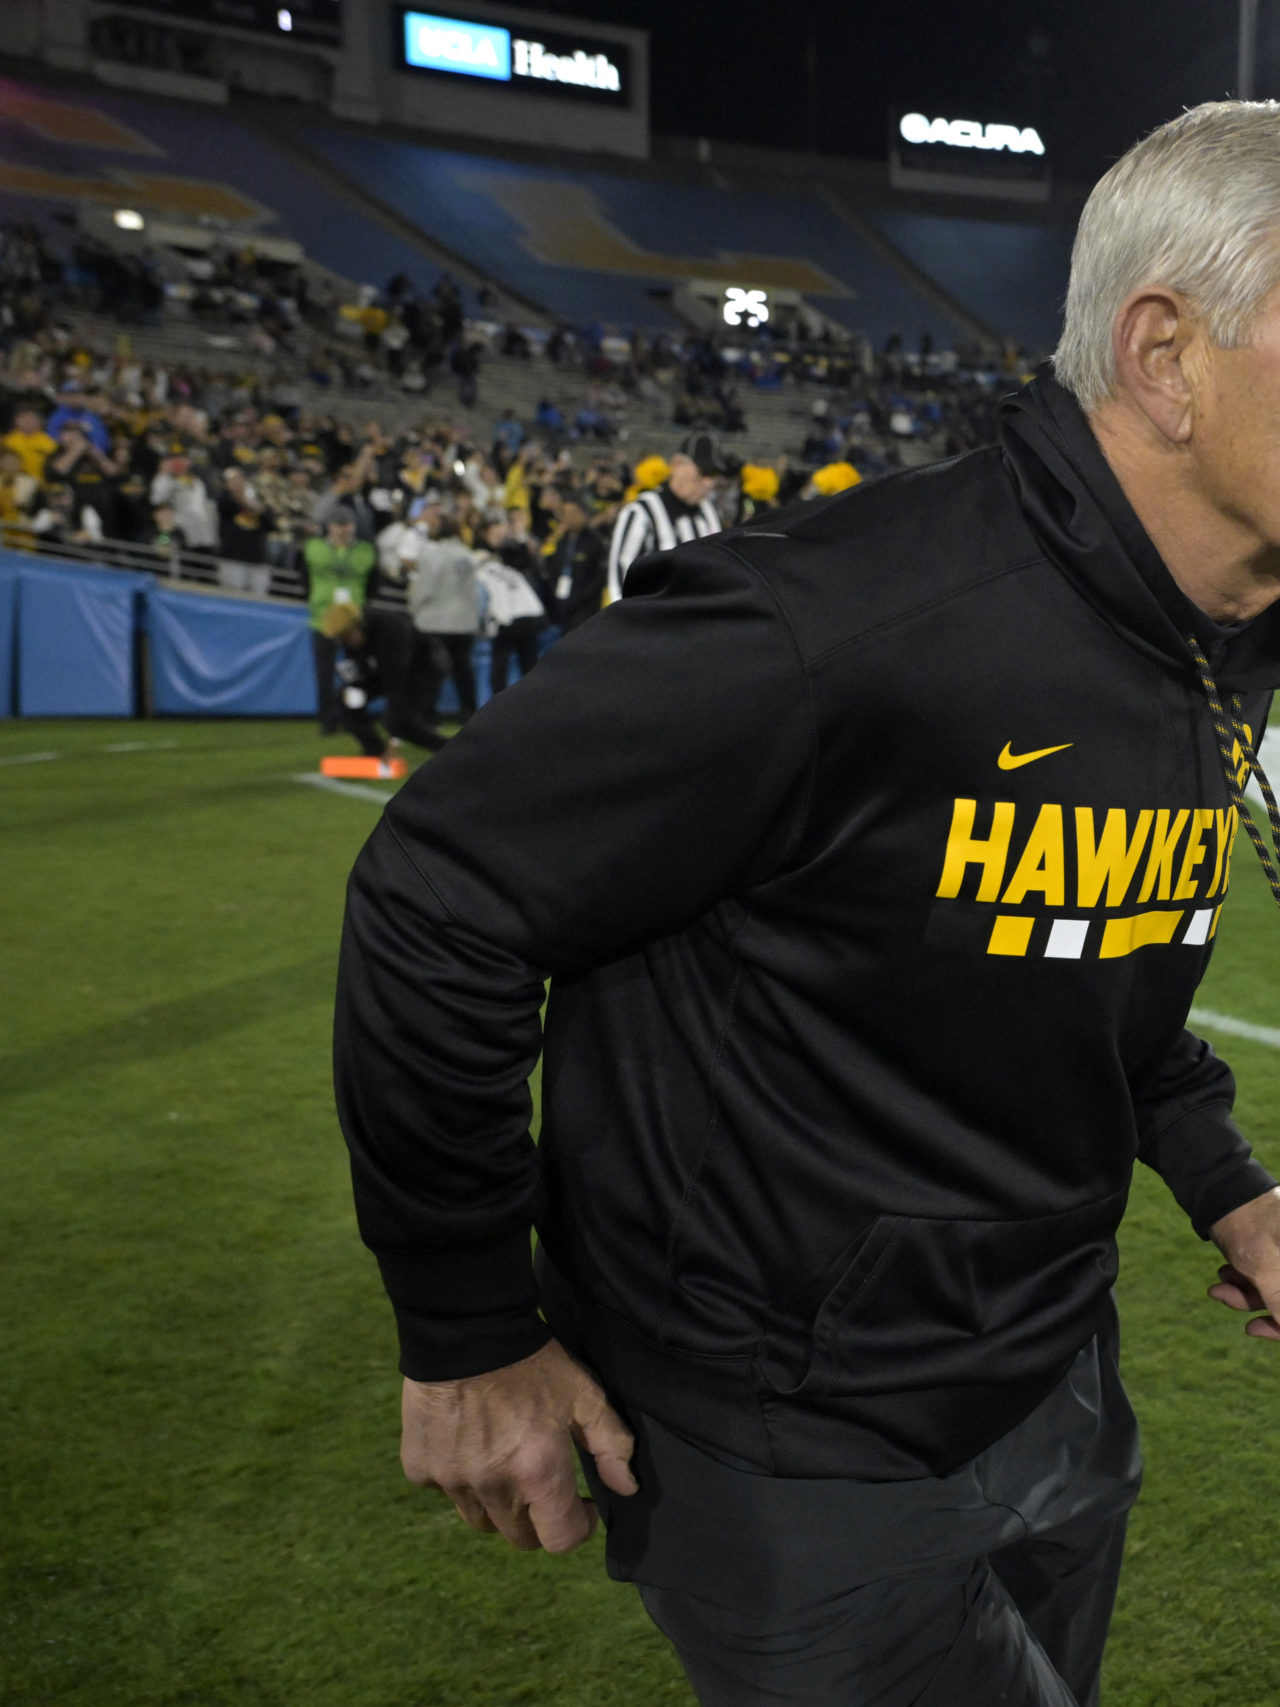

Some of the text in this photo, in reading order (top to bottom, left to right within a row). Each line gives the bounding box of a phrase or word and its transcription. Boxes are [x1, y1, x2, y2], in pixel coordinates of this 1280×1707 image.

[418, 26, 621, 92] UCLA Health
[927, 117, 1046, 156] ACURA
[723, 287, 769, 328] 25
